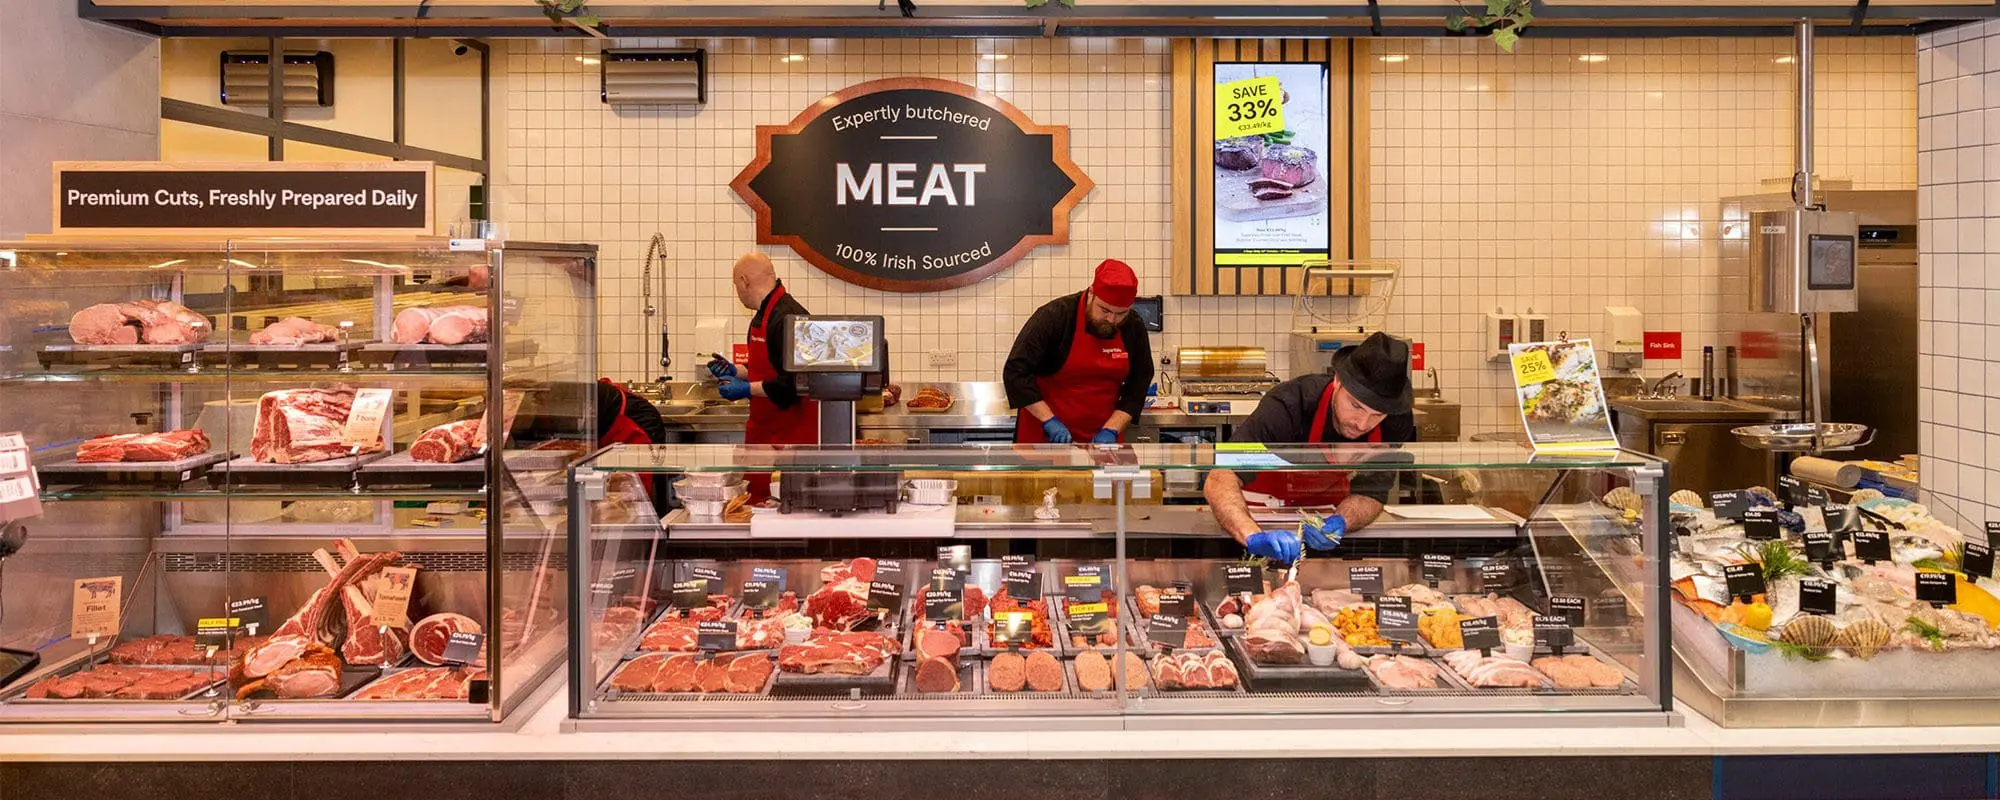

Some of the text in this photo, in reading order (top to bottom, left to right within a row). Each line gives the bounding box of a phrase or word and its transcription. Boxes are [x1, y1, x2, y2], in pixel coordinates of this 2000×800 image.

[1232, 84, 1267, 99] SAVE
[832, 105, 990, 132] Expertly butchered
[1227, 98, 1278, 122] 33%
[836, 163, 987, 207] MEAT
[67, 188, 418, 210] Premium Cuts, Freshly Prepared Daily
[835, 241, 992, 270] 100% Irish Sourced
[1520, 360, 1547, 374] 25%
[86, 604, 107, 613] Fillet
